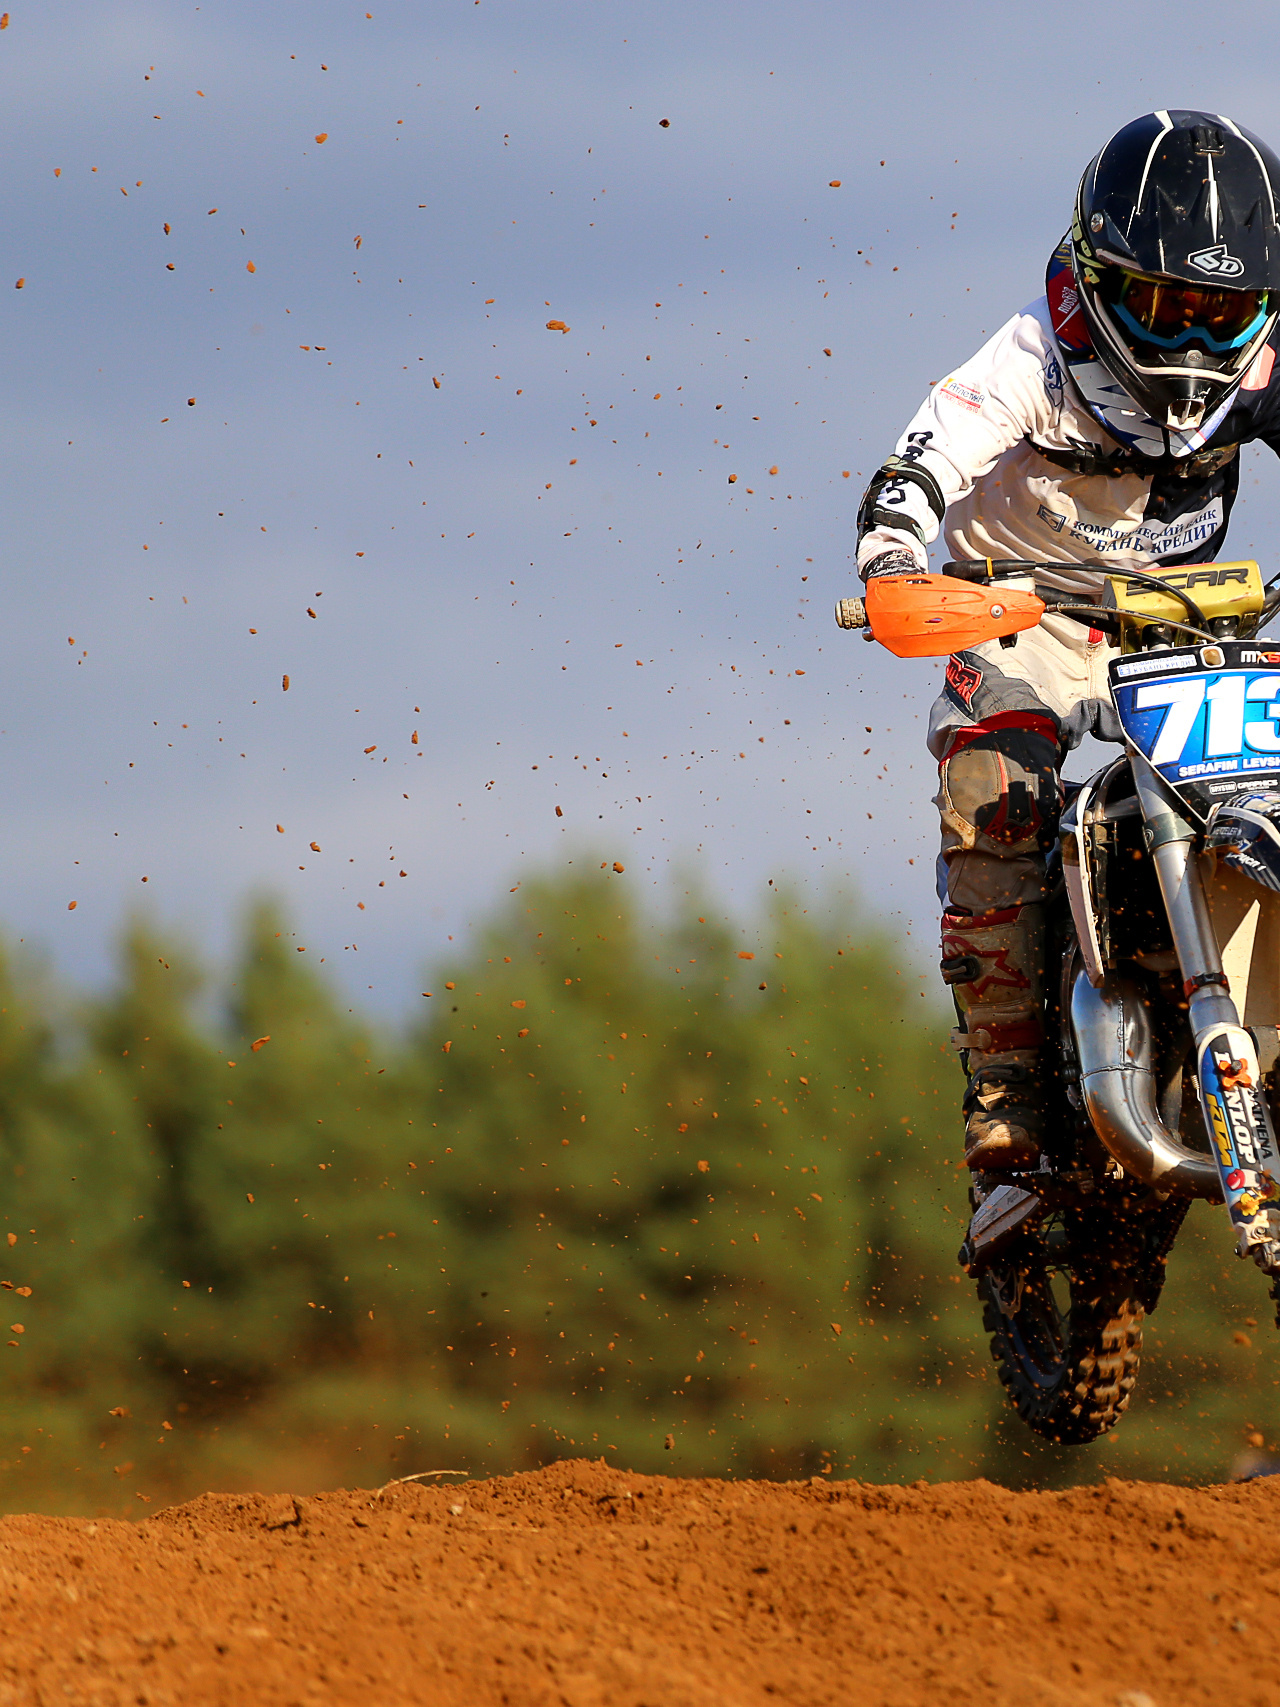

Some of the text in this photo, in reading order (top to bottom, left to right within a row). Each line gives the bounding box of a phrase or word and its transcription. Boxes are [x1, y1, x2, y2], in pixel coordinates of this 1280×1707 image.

[1069, 521, 1218, 553] КУБАНЬ КРЕДИТ
[1126, 568, 1249, 596] SCAR
[1178, 759, 1238, 778] SERAFIM
[1205, 1092, 1233, 1167] KTM
